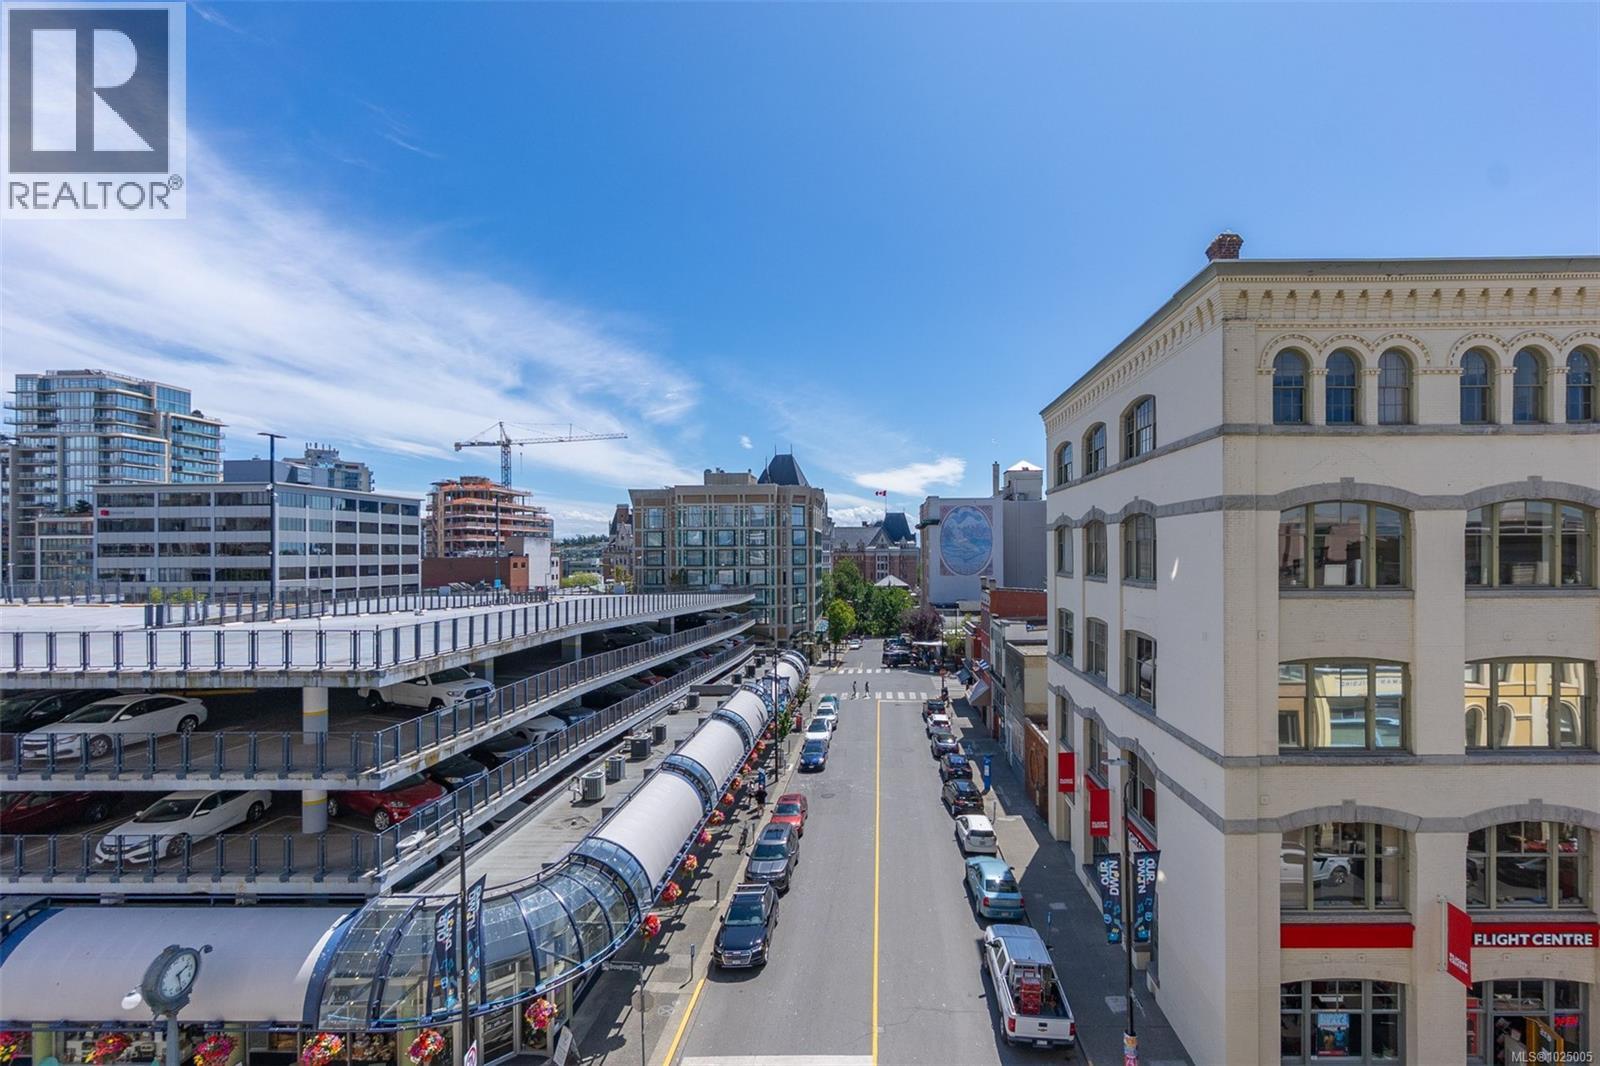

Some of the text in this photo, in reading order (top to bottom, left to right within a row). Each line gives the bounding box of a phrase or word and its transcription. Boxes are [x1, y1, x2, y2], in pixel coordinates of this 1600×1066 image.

[1101, 861, 1109, 886] OUR
[1145, 858, 1156, 882] OUR
[437, 912, 448, 942] OUR
[1474, 933, 1593, 946] FLIGHT CENTRE
